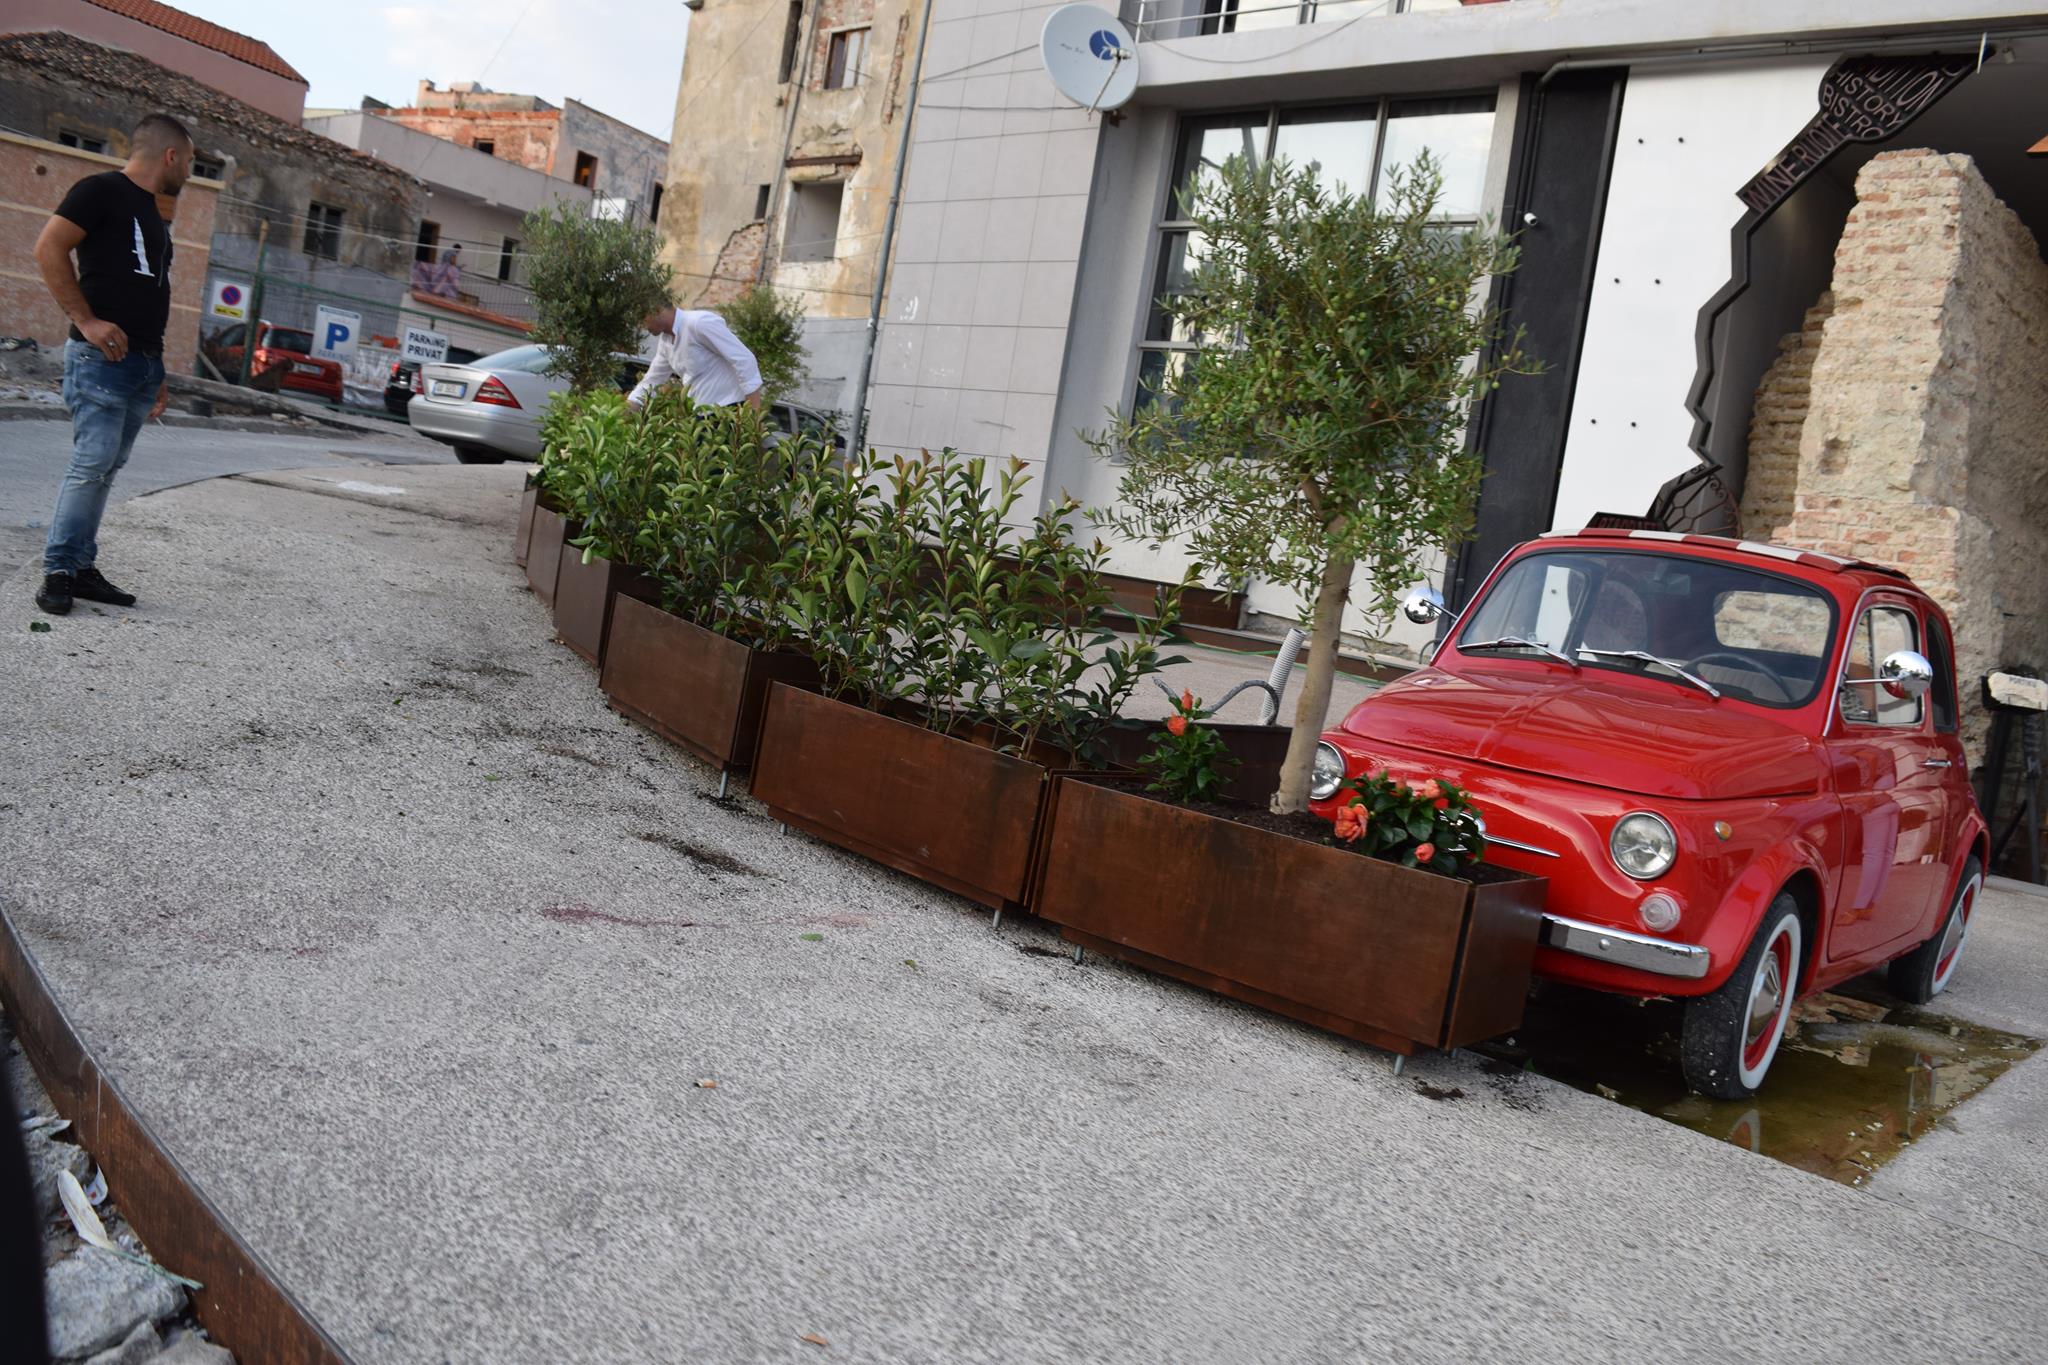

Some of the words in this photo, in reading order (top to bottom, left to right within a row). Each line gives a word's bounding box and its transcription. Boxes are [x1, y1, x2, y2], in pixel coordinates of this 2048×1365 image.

[1821, 83, 1885, 138] BISTRO
[1830, 68, 1903, 128] HISTORY
[1741, 154, 1806, 212] WINE
[325, 322, 350, 350] P
[407, 344, 443, 360] PRIVAT
[408, 331, 446, 349] PARKING
